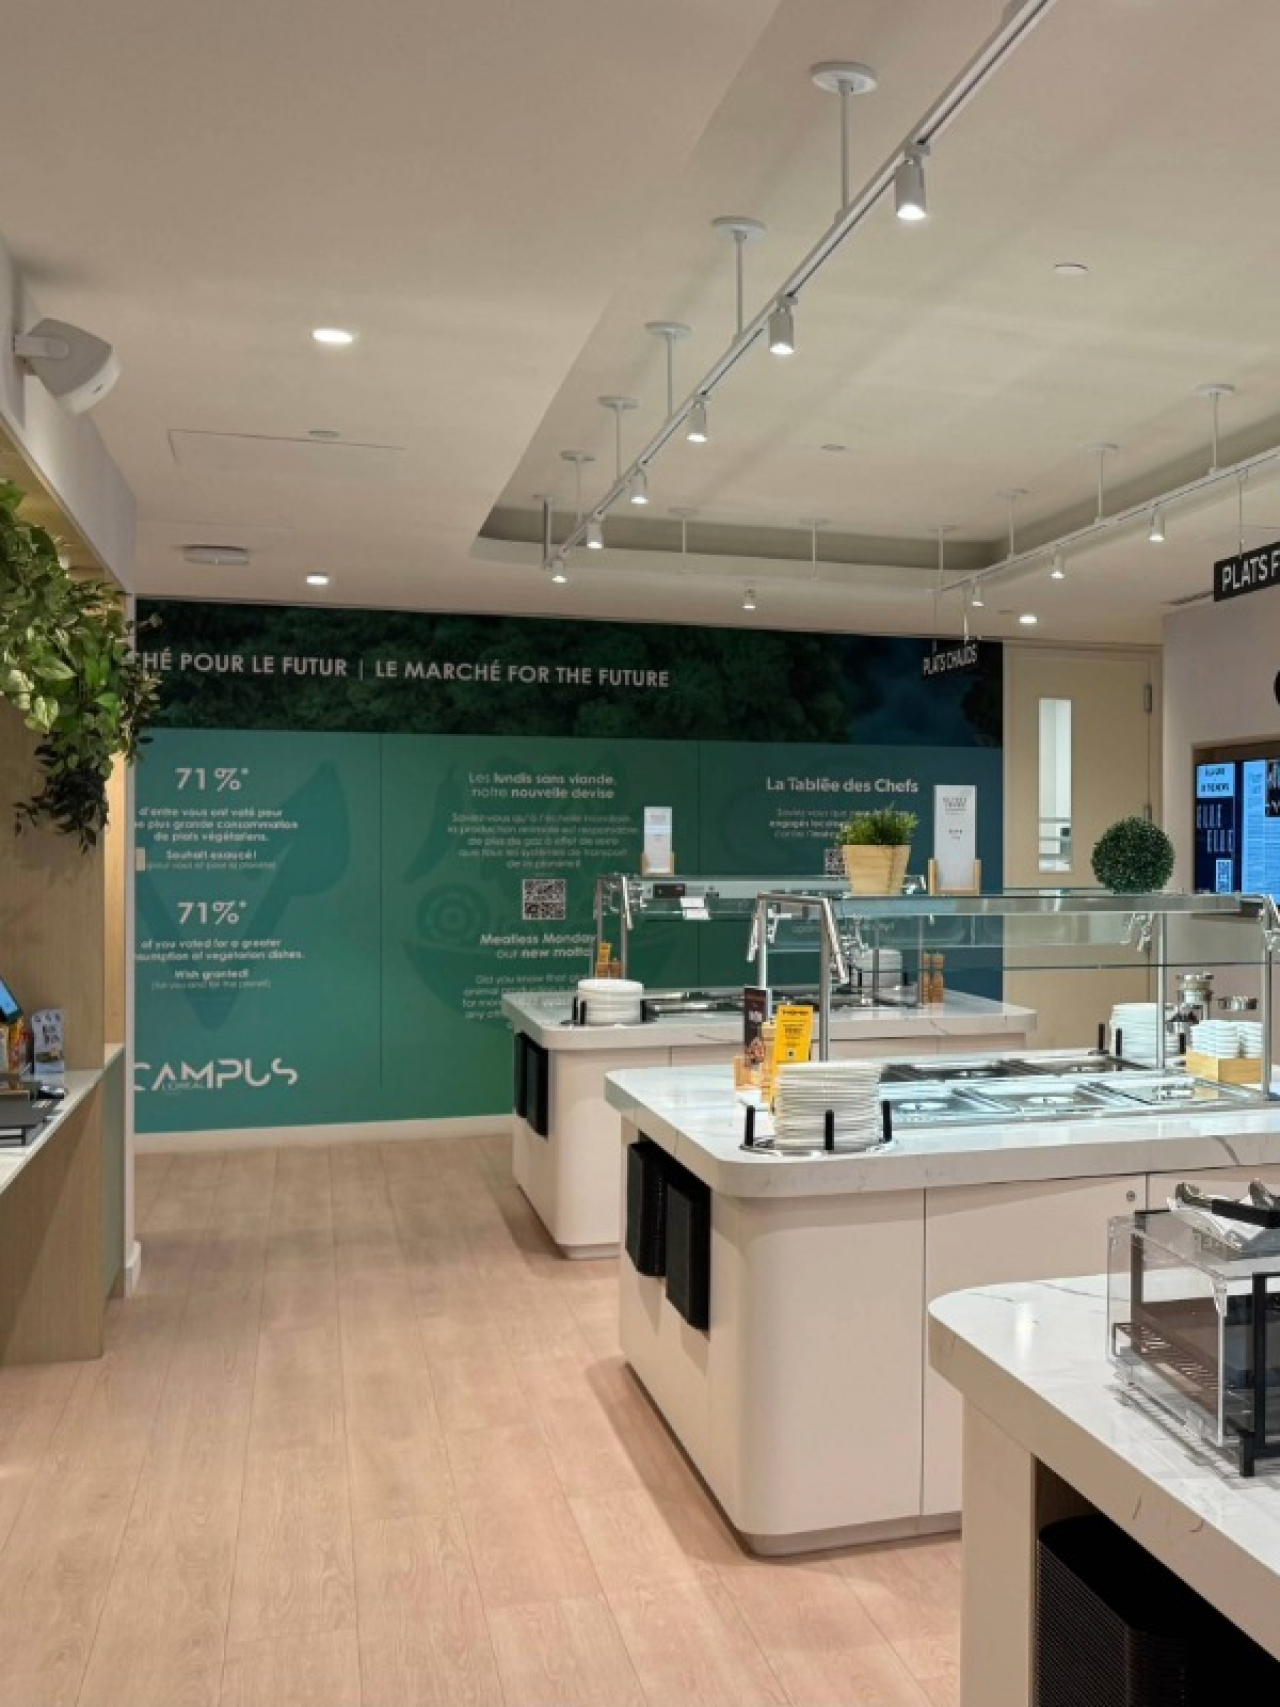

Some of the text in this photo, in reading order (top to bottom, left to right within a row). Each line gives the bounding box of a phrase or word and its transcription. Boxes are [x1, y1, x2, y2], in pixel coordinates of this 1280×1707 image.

[1222, 554, 1268, 592] PLATS
[180, 652, 244, 673] POUR
[252, 654, 274, 674] LE
[282, 656, 348, 677] FUTUR
[375, 659, 398, 678] LE
[404, 660, 500, 682] MARCHÉ
[507, 664, 549, 683] FOR
[556, 667, 592, 685] THE
[599, 668, 670, 688] FUTURE
[469, 772, 490, 786] Les
[493, 772, 532, 786] lundis
[535, 772, 565, 786] sans
[766, 777, 919, 793] La Tablée des Chefs
[471, 786, 615, 799] notre nouvelle devise
[542, 932, 596, 945] Monday
